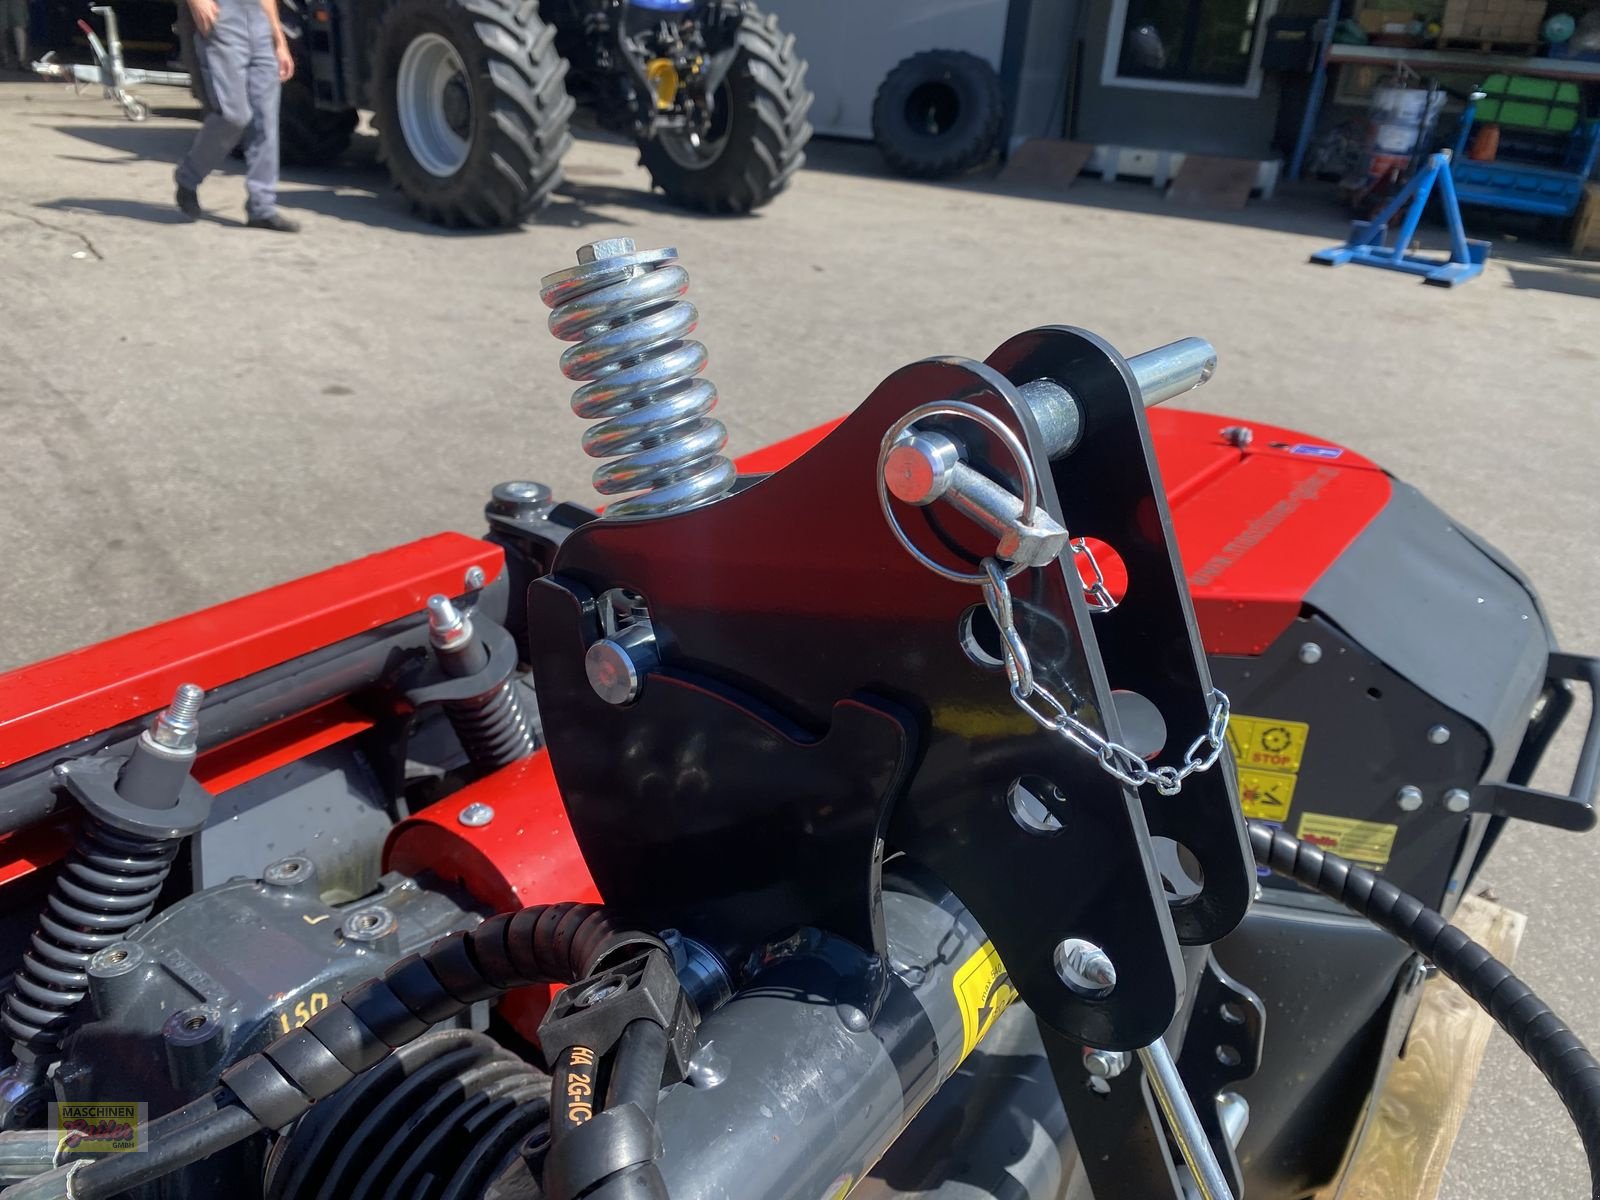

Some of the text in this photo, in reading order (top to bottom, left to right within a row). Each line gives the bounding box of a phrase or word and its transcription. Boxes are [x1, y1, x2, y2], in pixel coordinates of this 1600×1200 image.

[1251, 751, 1291, 766] STOP
[981, 963, 1002, 1002] max 540
